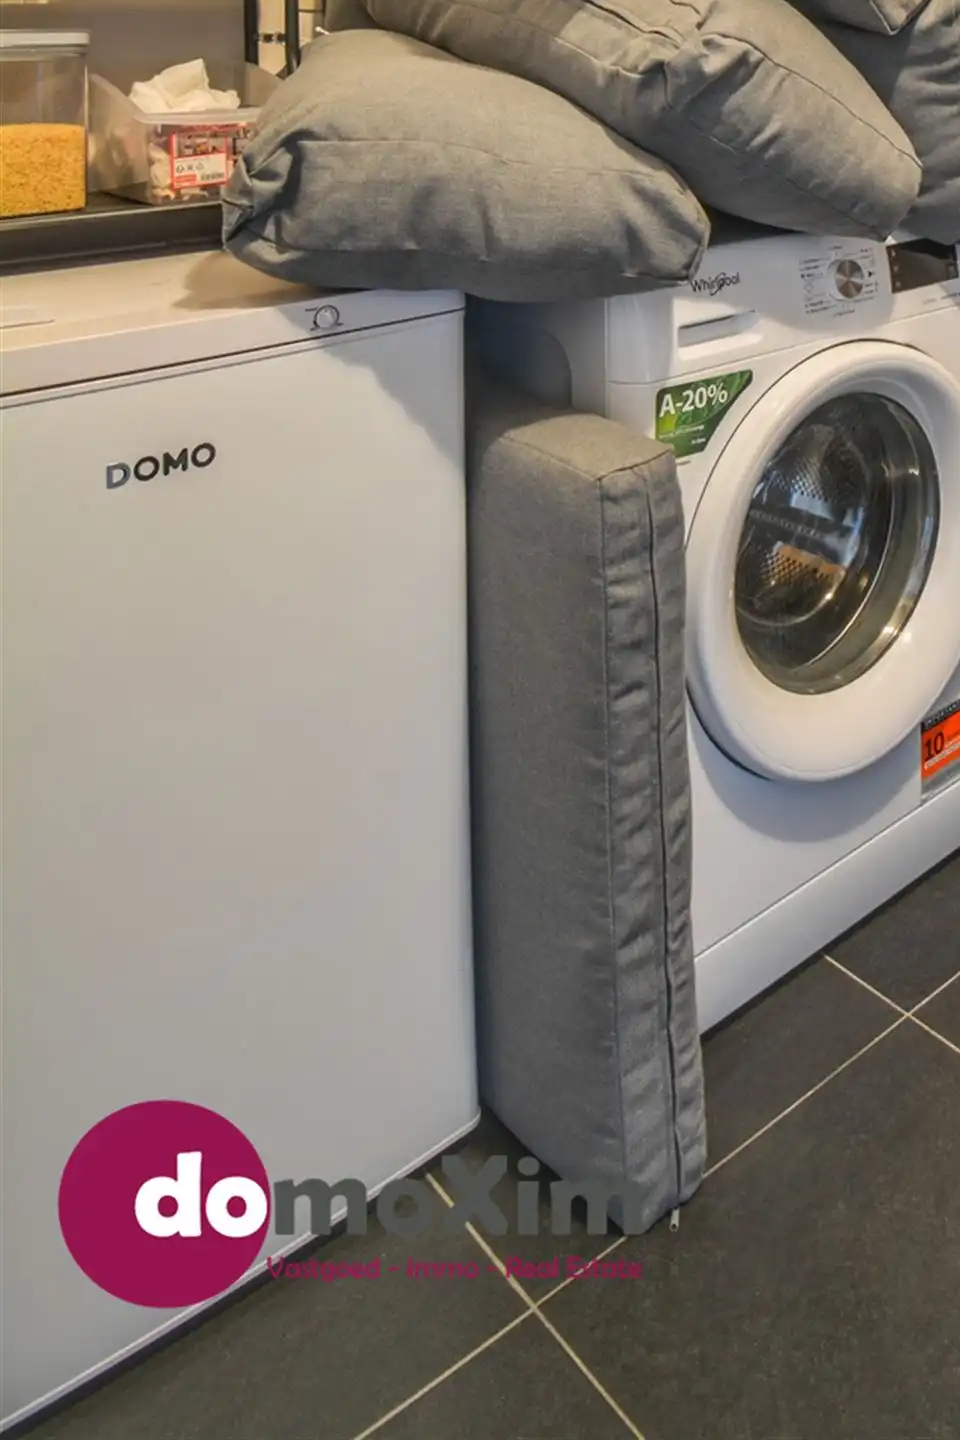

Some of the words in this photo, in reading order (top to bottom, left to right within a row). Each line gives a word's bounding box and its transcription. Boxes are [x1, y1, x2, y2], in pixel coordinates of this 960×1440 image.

[691, 272, 740, 296] Whirlpool
[660, 383, 728, 417] A-20%
[106, 442, 216, 490] DOMO
[925, 731, 944, 762] 10
